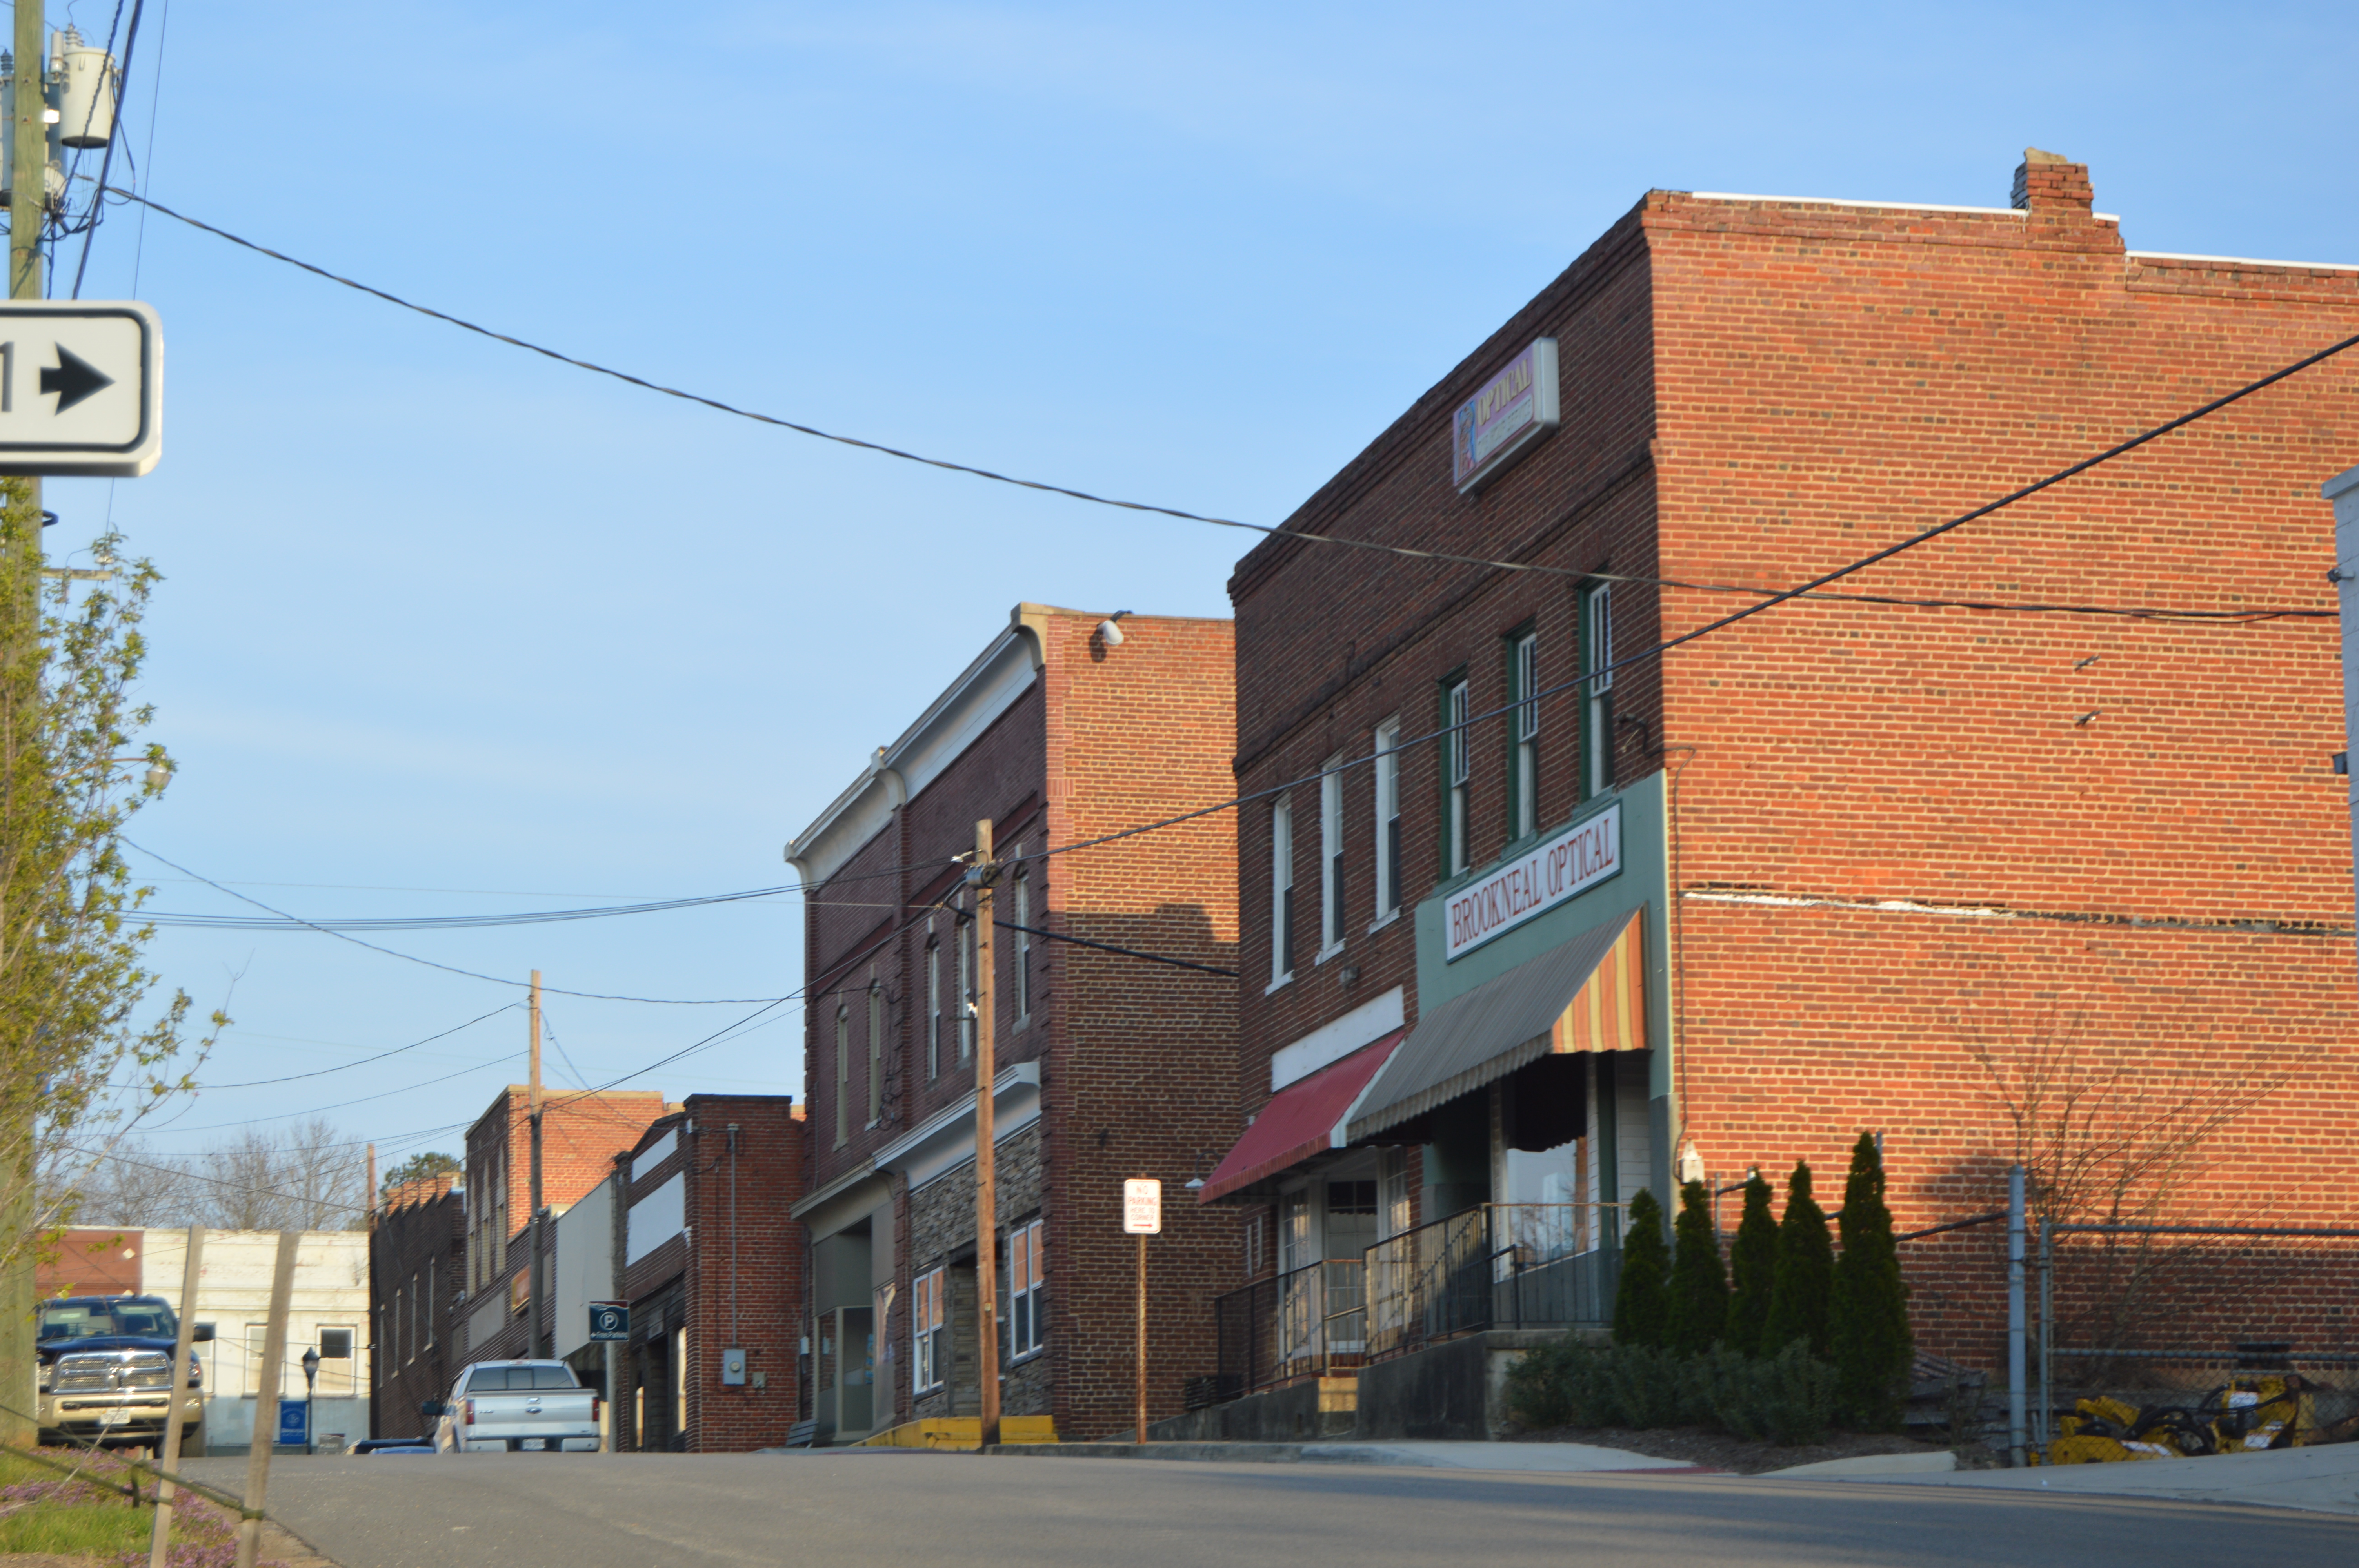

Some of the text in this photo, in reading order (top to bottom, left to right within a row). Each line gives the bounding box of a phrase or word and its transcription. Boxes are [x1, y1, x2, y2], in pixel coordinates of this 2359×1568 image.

[1478, 358, 1532, 426] OPTICAL
[1452, 818, 1615, 948] BROOKNEAL OPTICAL
[1136, 1185, 1149, 1194] NO
[1128, 1196, 1157, 1206] PARKING
[604, 1315, 614, 1327] P
